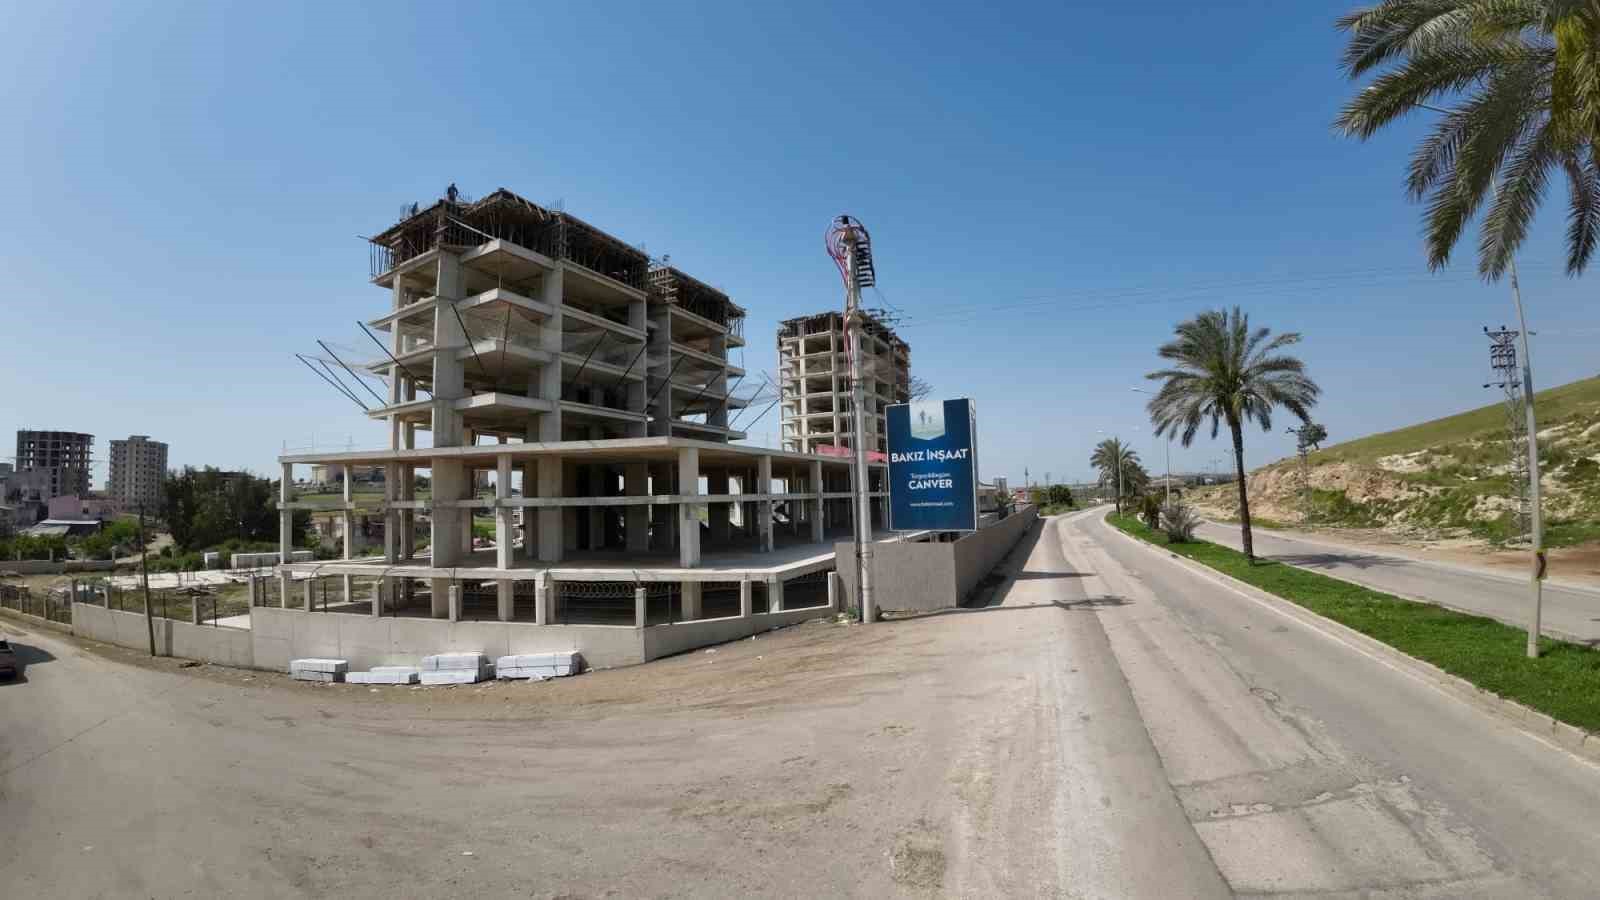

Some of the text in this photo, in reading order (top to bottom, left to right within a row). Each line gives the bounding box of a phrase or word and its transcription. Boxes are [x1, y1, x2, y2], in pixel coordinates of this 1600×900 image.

[891, 448, 968, 463] BAKIZ İNŞAAT
[908, 479, 952, 490] CANVER
